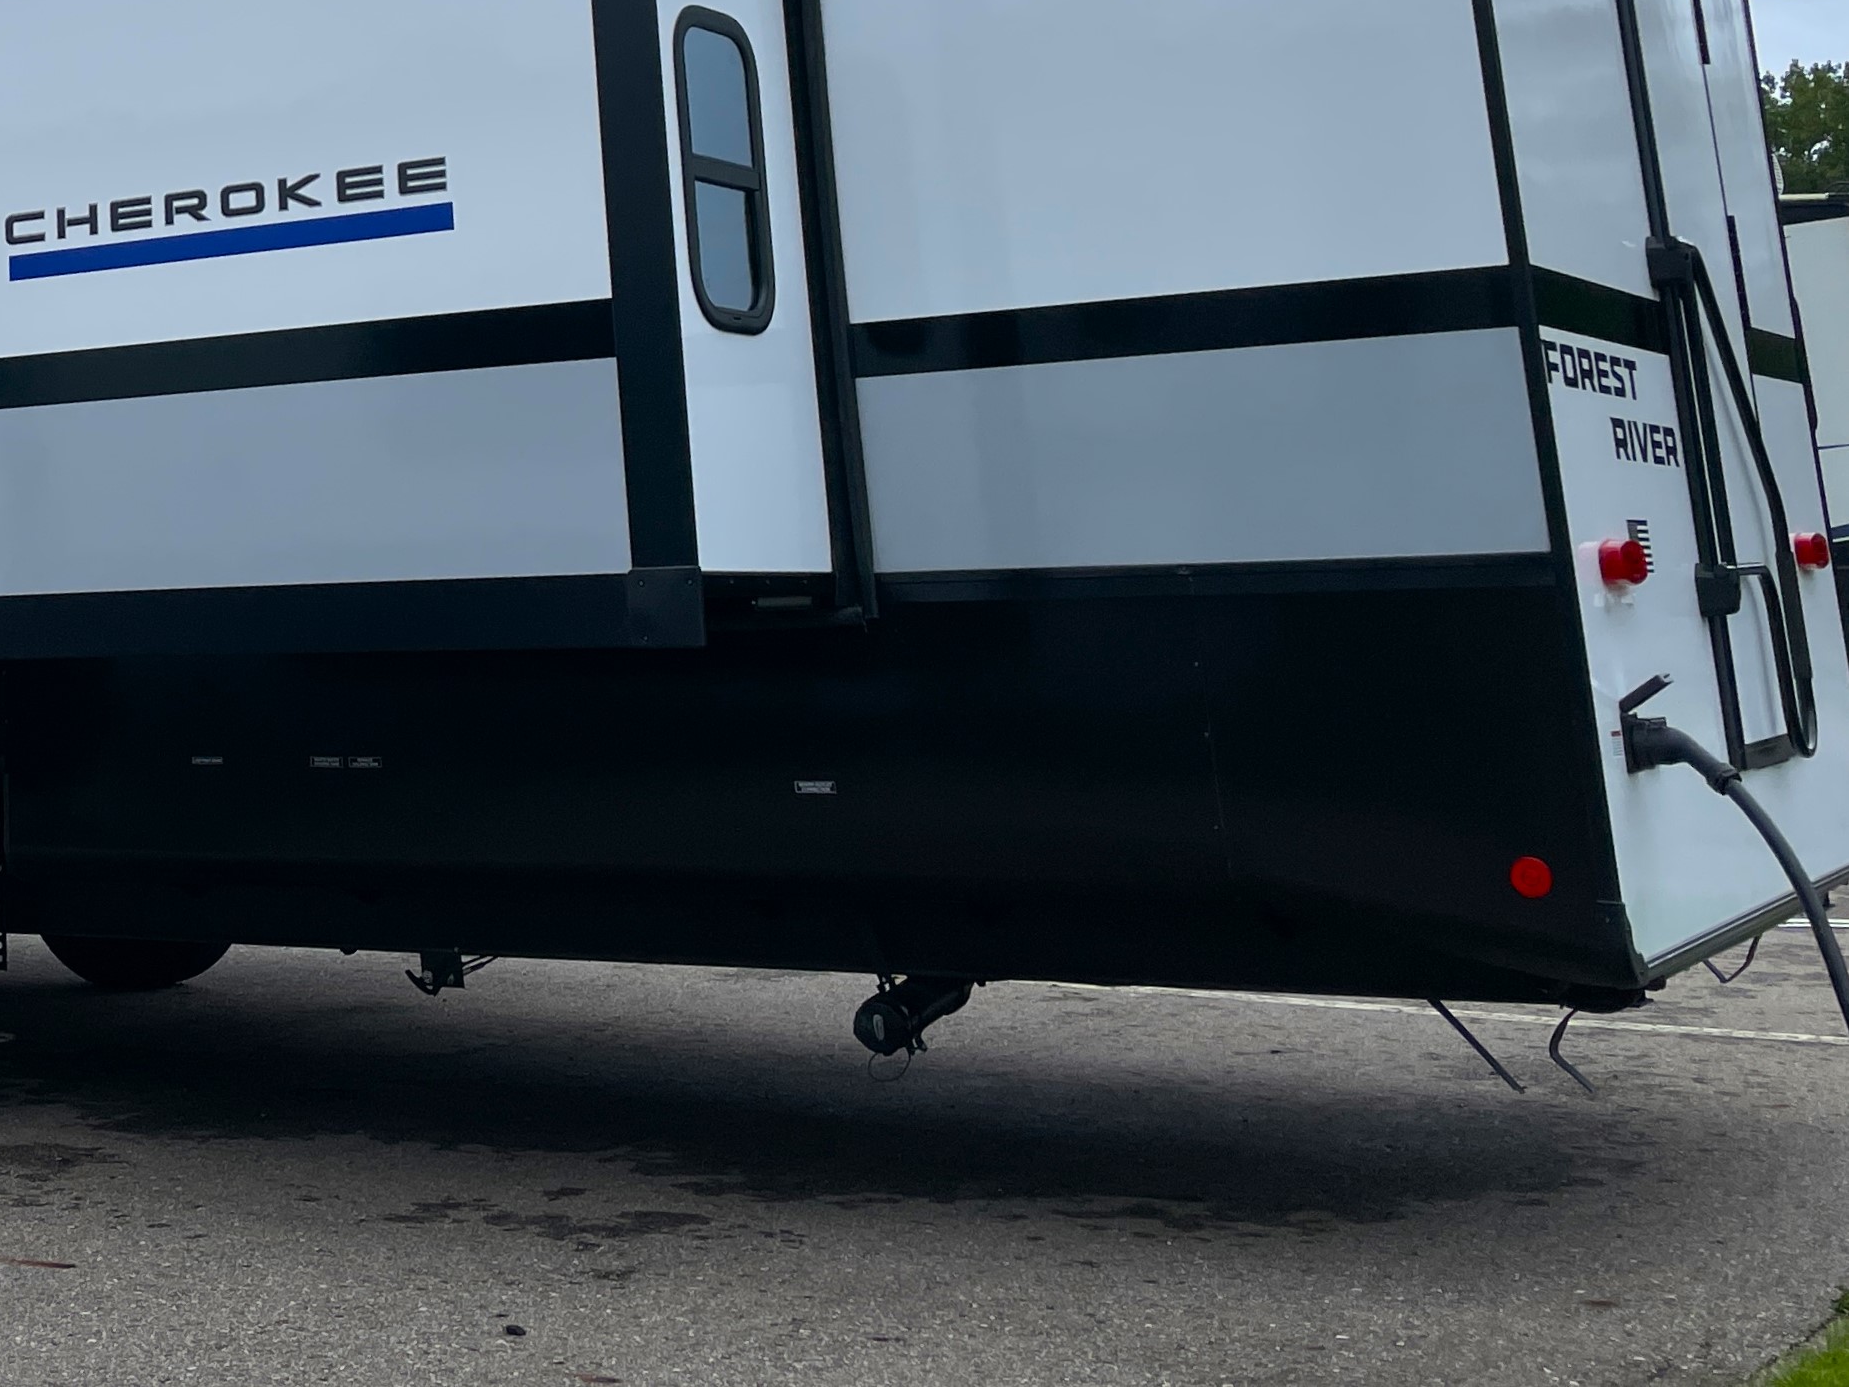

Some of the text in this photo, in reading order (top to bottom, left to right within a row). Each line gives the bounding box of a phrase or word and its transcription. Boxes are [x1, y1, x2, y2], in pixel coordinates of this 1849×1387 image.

[4, 156, 448, 245] CHEROKEE
[1541, 340, 1637, 400] FOREST
[1610, 417, 1680, 467] RIVER
